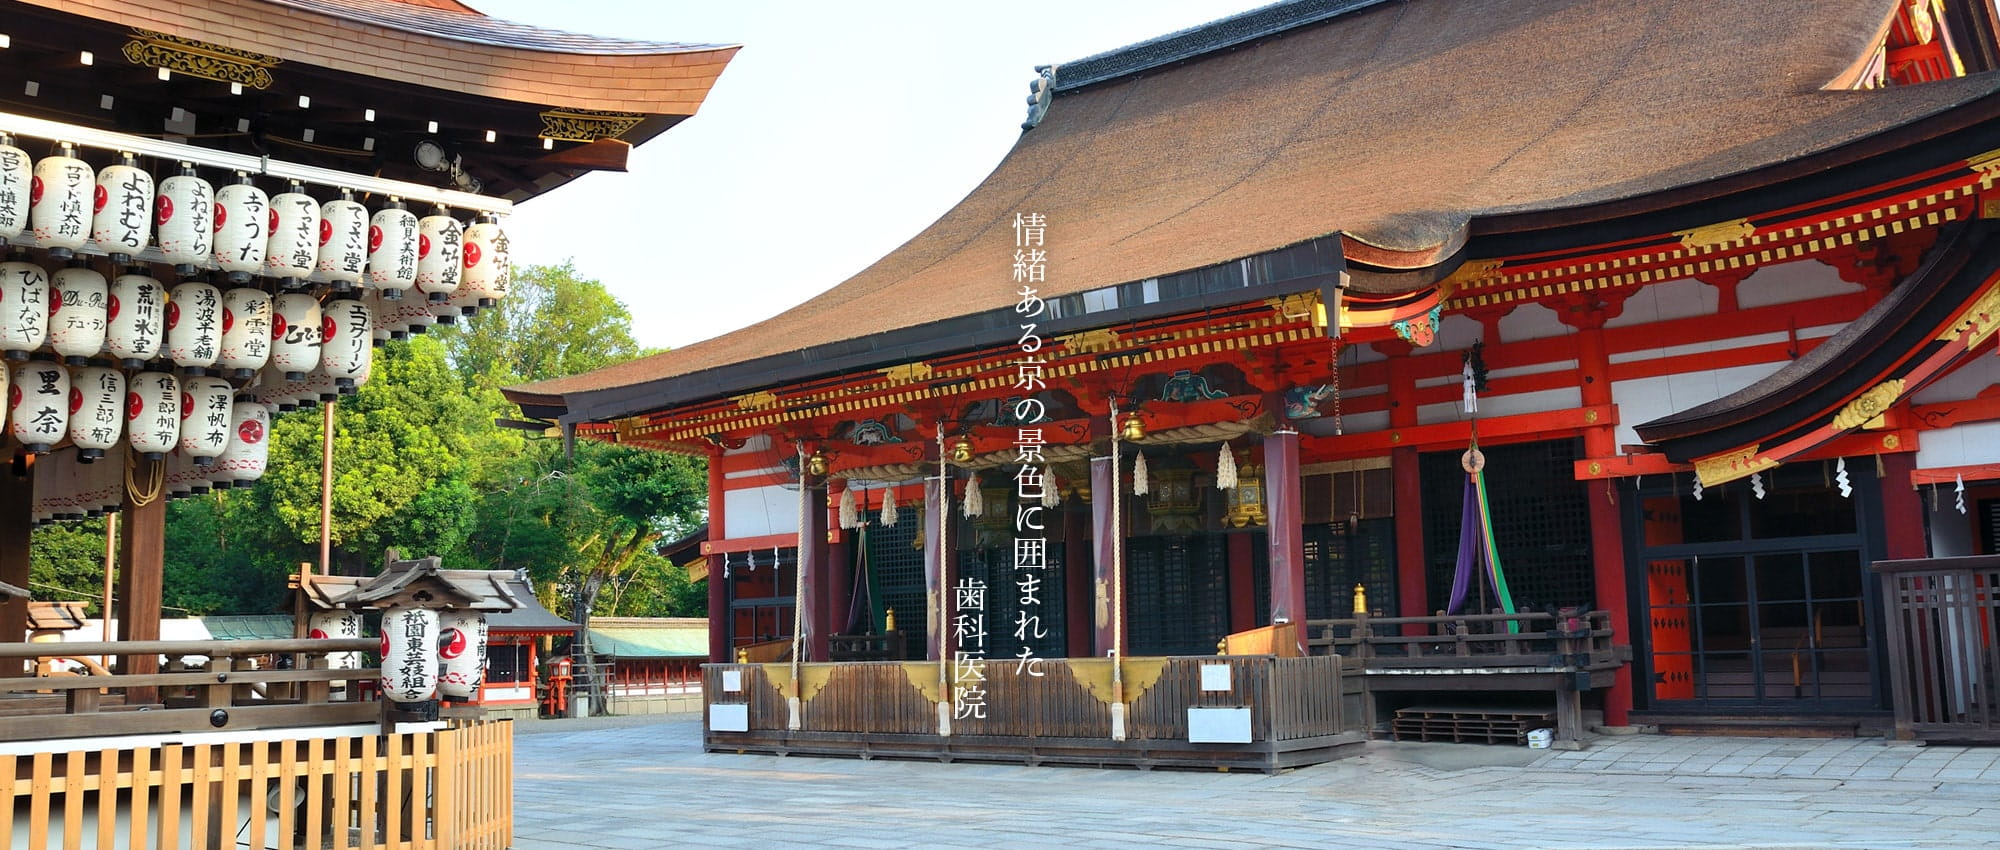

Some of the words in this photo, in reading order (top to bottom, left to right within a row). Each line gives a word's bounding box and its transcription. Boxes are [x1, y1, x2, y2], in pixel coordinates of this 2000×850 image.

[120, 172, 146, 248] よねむら
[190, 181, 208, 255] よねむら
[292, 199, 314, 270] てっさい堂
[343, 205, 363, 274] てっさい堂
[438, 221, 462, 285] 金竹堂
[490, 229, 510, 293] 金竹堂
[16, 270, 43, 343] ひばなや
[132, 284, 154, 354] 荒川氷室
[191, 289, 216, 360] 湯波半老舗
[244, 299, 267, 359] 彩雲堂
[31, 371, 62, 434] 里奈
[154, 377, 176, 446] 信三郎帆布
[206, 384, 229, 448] 一澤帆布
